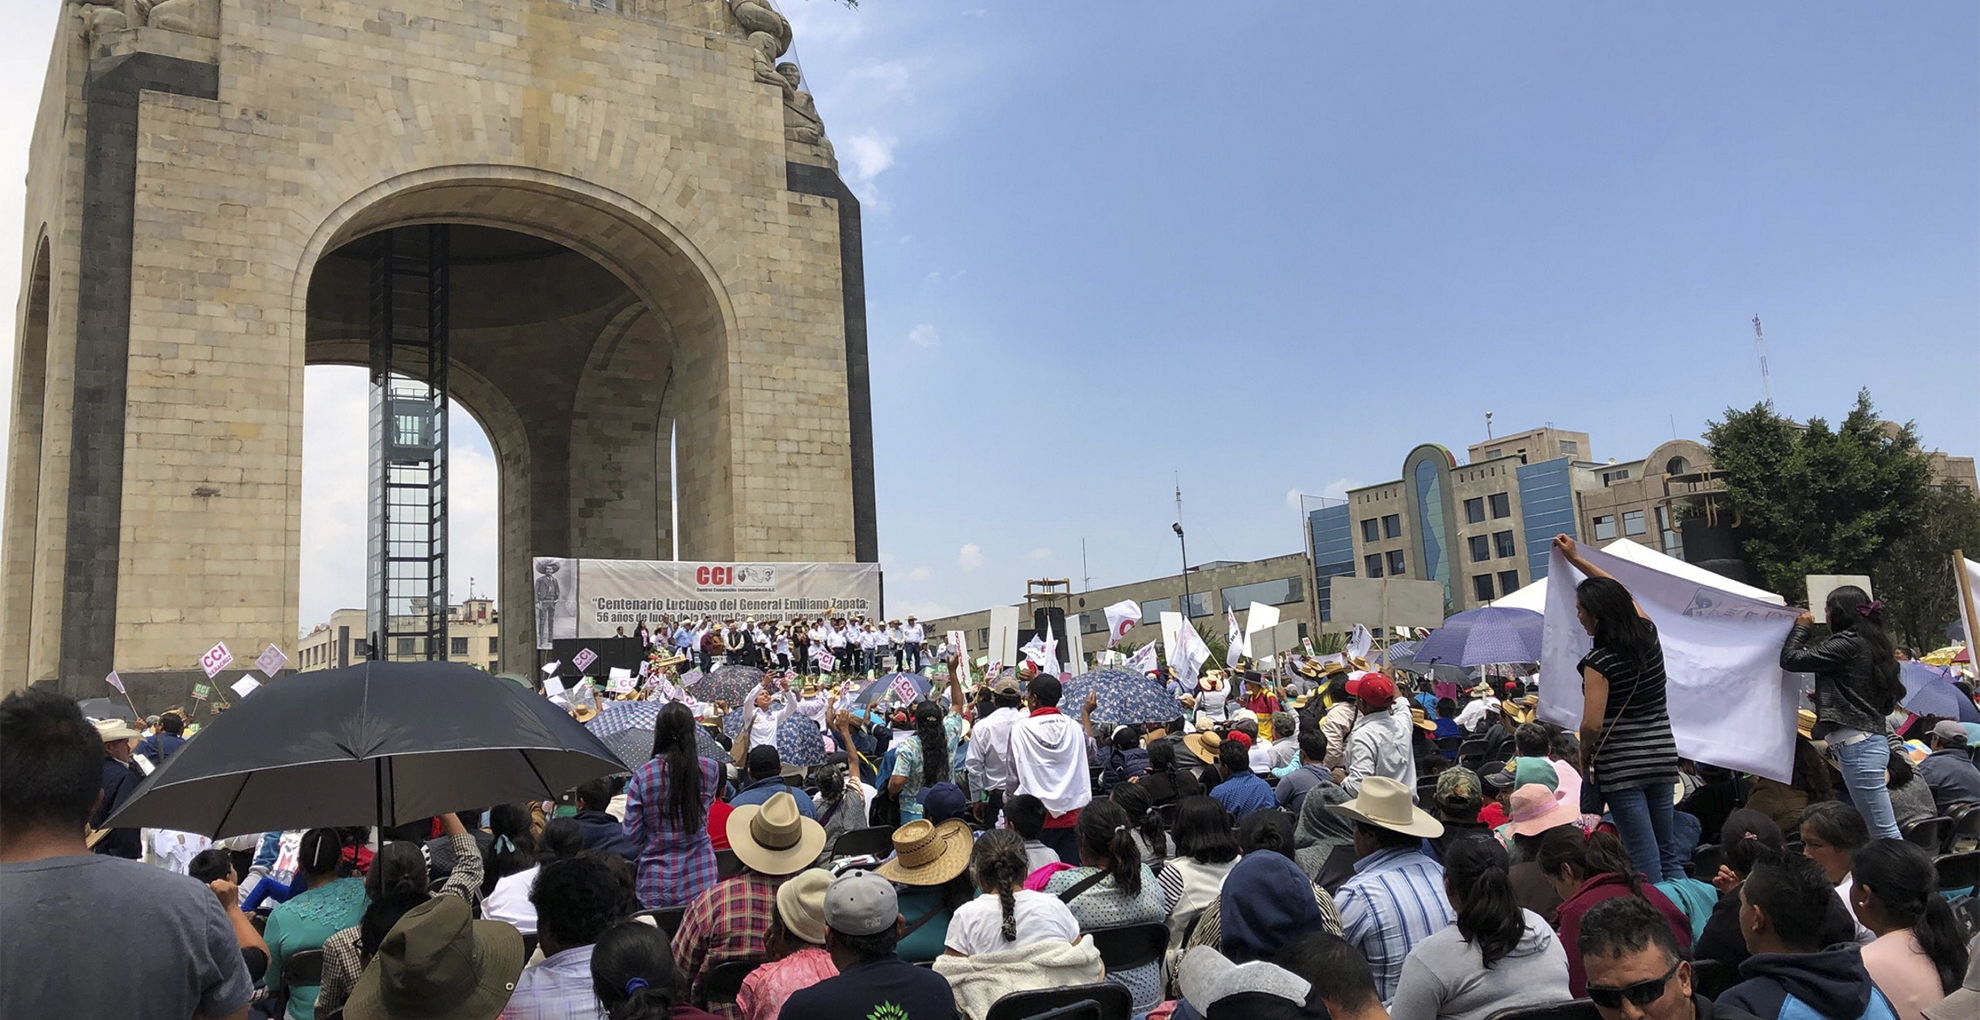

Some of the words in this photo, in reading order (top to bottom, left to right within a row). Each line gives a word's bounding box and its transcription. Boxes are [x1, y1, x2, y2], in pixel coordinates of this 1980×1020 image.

[696, 566, 733, 585] CCI
[666, 598, 717, 610] Luctuoso
[720, 599, 737, 610] del
[740, 599, 781, 610] General
[784, 598, 829, 610] Emiliano
[597, 612, 609, 622] 56
[611, 612, 634, 622] años
[636, 612, 647, 622] de
[649, 613, 675, 622] luca
[735, 612, 783, 622] Capesina
[203, 645, 227, 668] CCI
[574, 650, 591, 666] CCI
[207, 655, 232, 676] VERACRUZ
[195, 684, 211, 694] CCI
[901, 681, 916, 700] CCI
